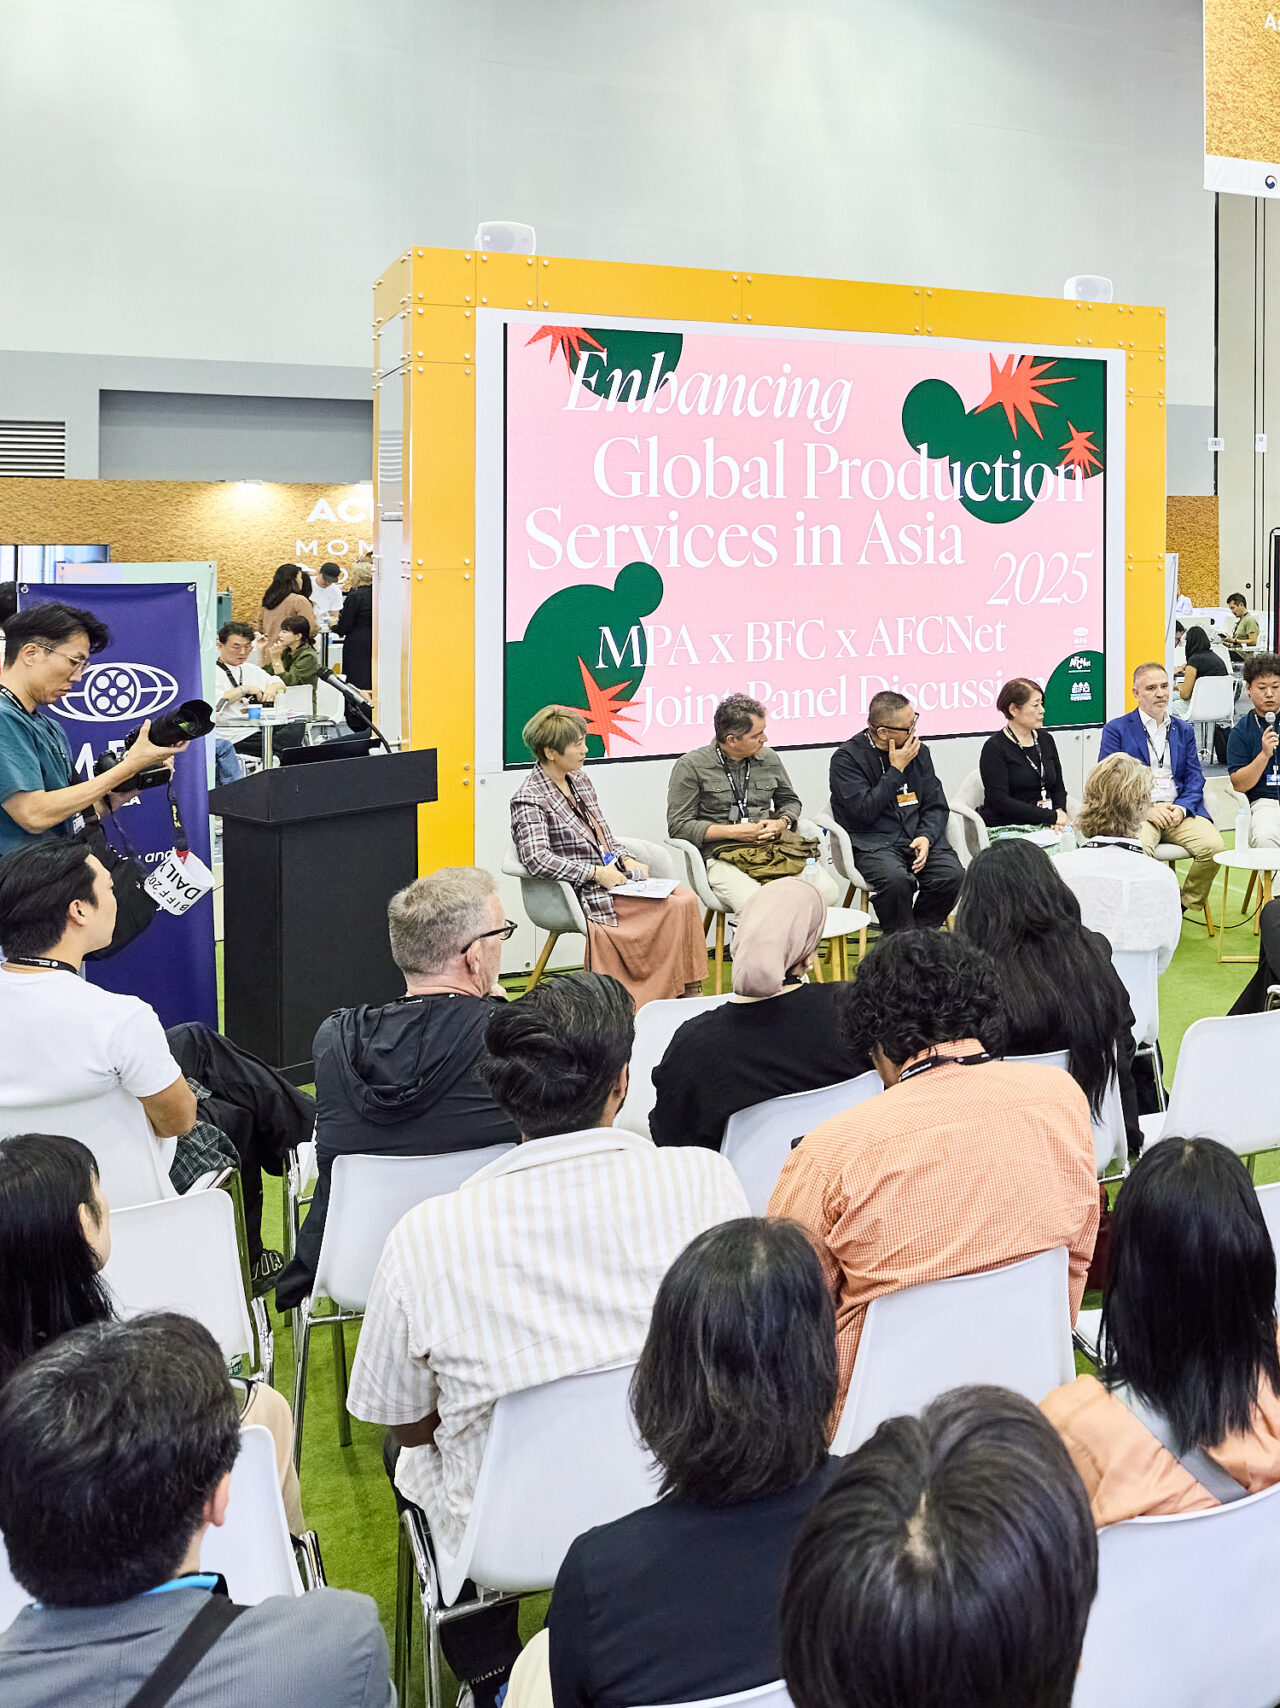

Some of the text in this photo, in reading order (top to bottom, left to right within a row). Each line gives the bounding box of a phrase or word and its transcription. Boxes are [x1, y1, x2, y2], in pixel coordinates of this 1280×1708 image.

[563, 348, 853, 436] Enhancing
[593, 434, 1085, 504] Global Production
[306, 498, 374, 522] AC
[525, 506, 966, 571] Services in Asia
[986, 548, 1095, 608] 2025
[595, 614, 1007, 669] MPA x BFC x AFCNet
[159, 889, 190, 911] BIFF
[160, 859, 201, 900] DAILY
